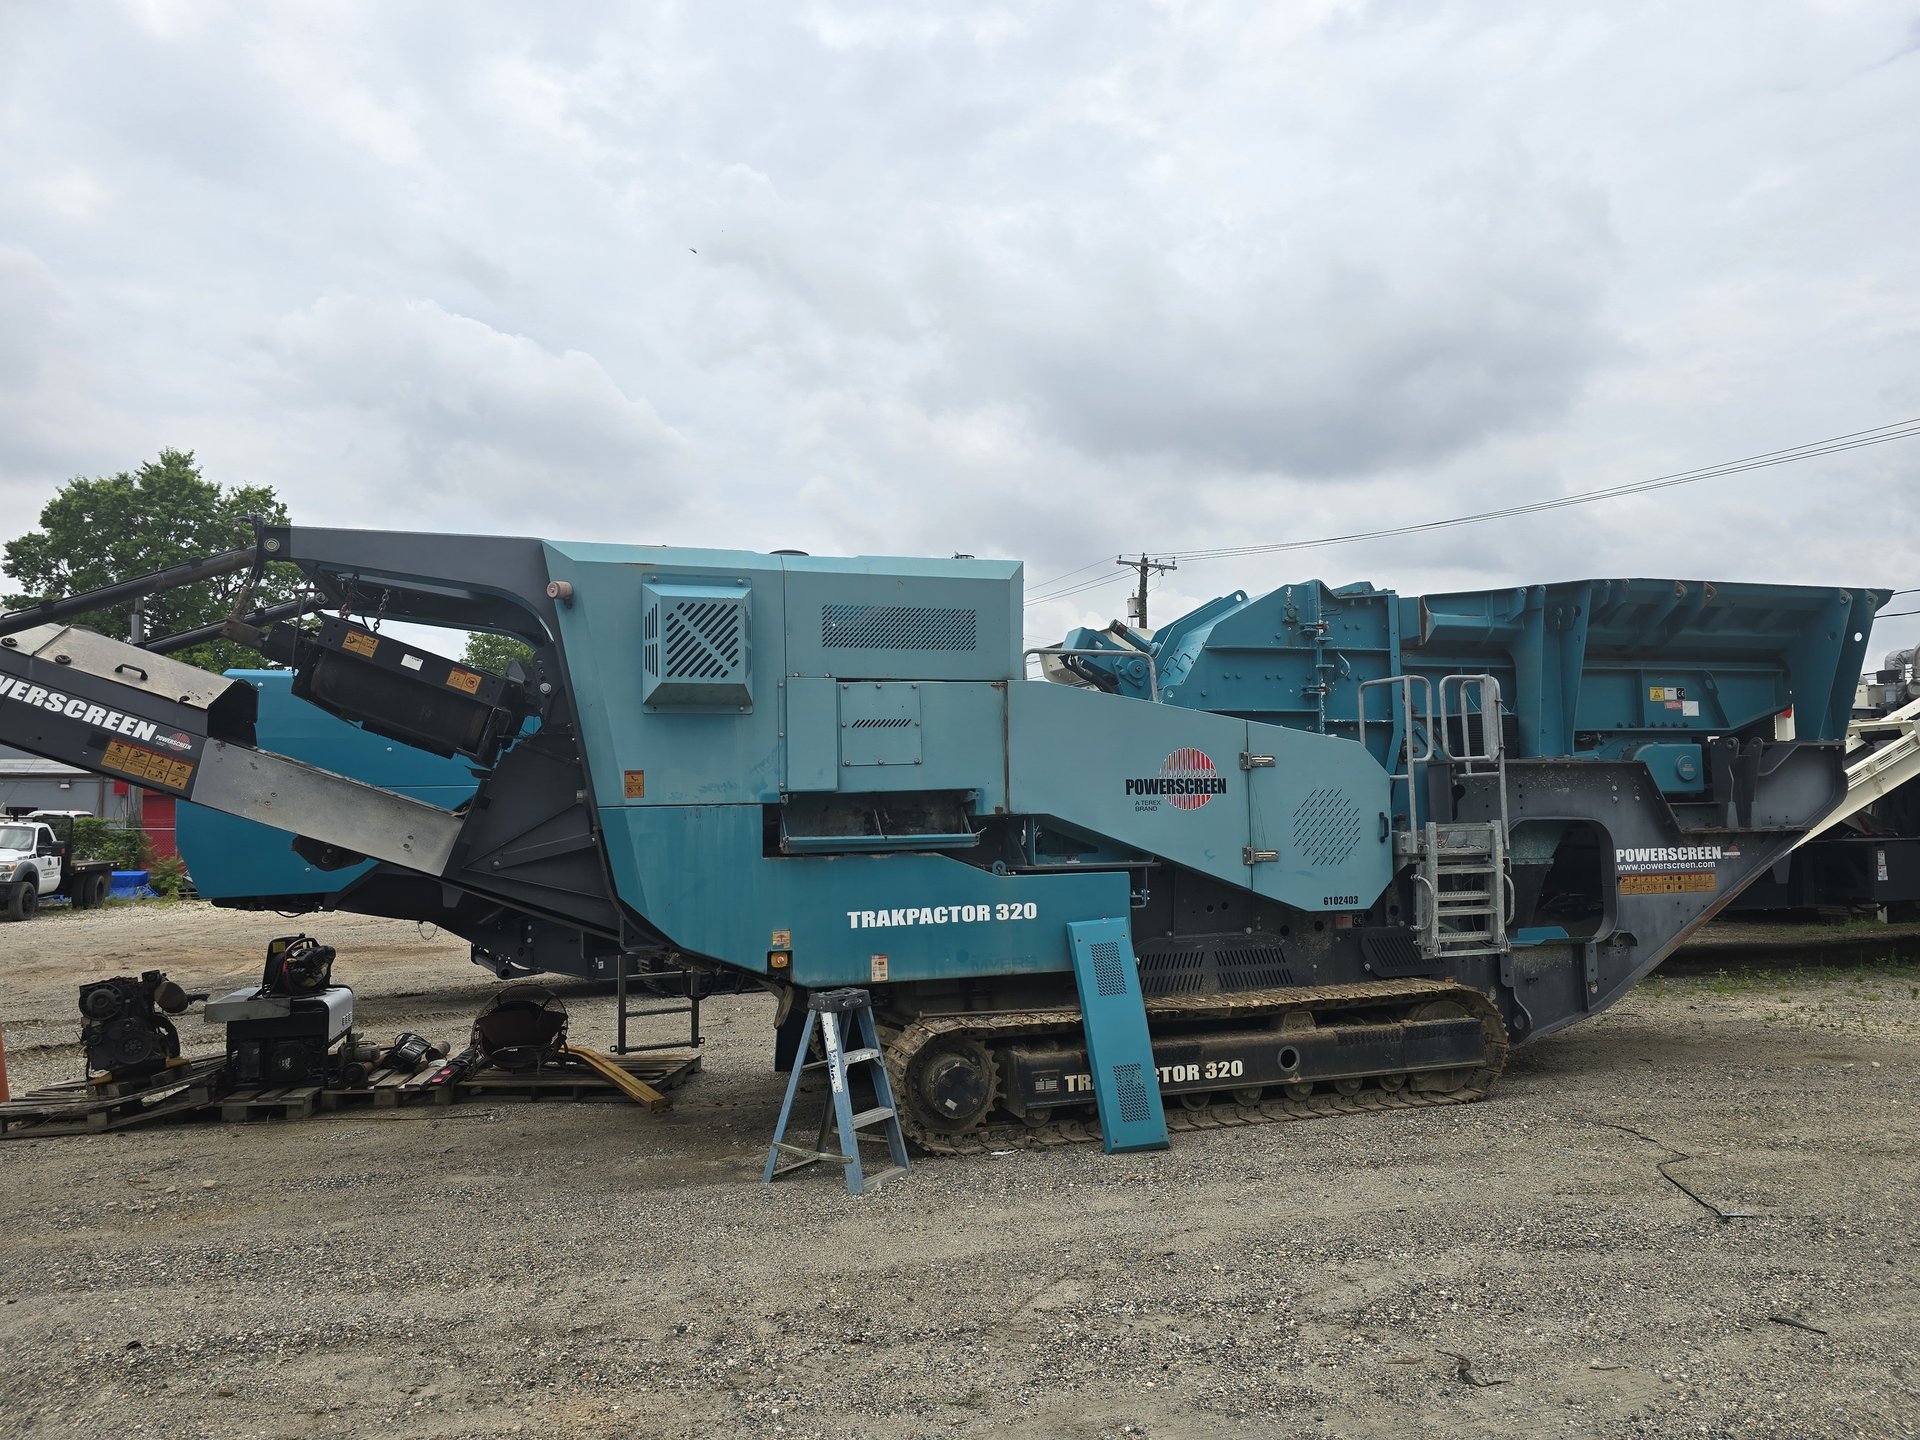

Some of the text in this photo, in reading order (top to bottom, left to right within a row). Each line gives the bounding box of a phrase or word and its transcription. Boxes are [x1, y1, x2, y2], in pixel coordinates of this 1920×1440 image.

[1125, 778, 1227, 796] POWERSCREEN
[1615, 846, 1722, 862] POWERSCREEN
[1617, 861, 1716, 872] www.powerscreen.com
[1323, 896, 1359, 906] 6102403
[847, 902, 1038, 929] TRAKPACTOR 320
[1204, 1059, 1244, 1081] 320
